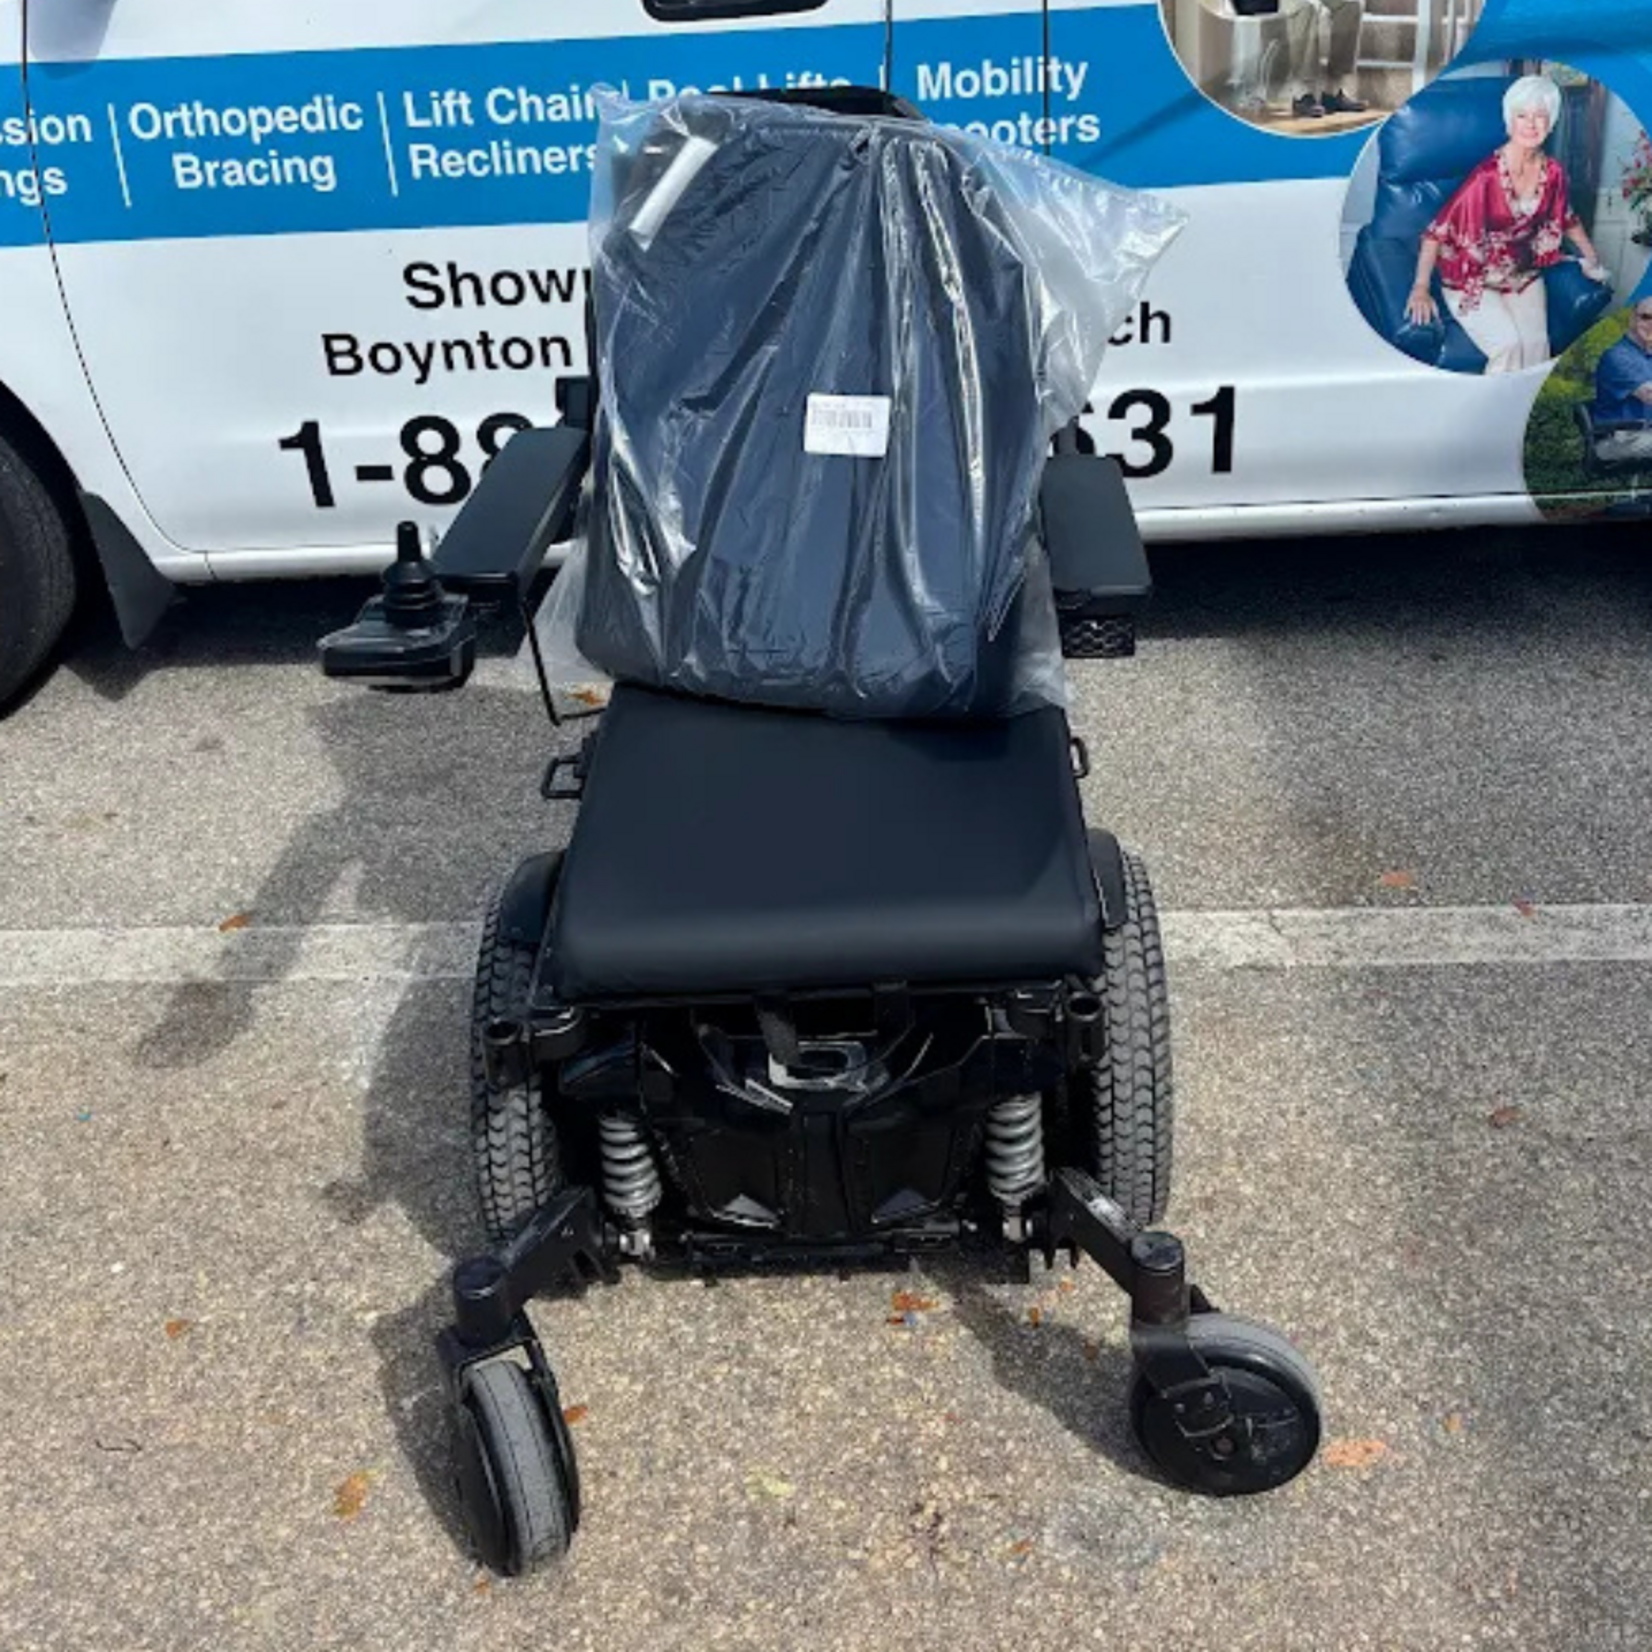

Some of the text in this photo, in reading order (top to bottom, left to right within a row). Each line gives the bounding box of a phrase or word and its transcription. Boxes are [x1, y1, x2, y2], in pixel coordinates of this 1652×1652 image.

[917, 56, 1088, 101] Mobility
[0, 108, 93, 146] sion
[128, 95, 364, 144] Orthopedic
[404, 90, 472, 128] Lift
[929, 111, 1101, 147] oters
[172, 150, 337, 192] Bracing
[402, 261, 592, 310] Show
[321, 331, 573, 385] Boynton
